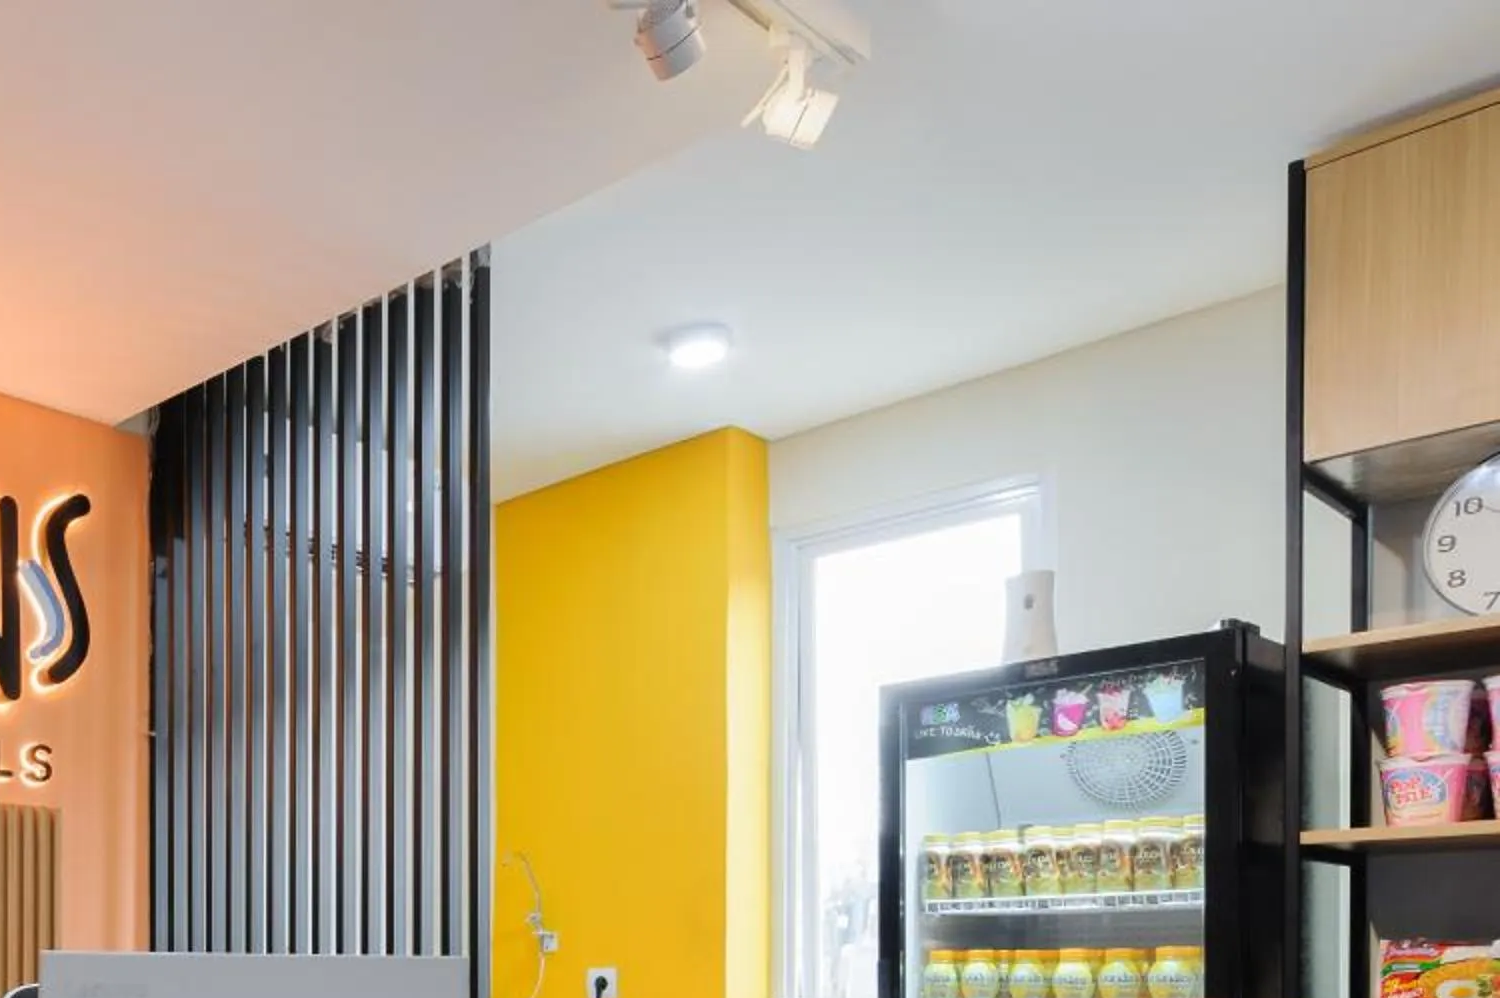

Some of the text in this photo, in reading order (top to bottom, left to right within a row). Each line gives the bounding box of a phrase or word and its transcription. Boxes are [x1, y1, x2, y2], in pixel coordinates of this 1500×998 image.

[1454, 497, 1484, 517] 10
[1437, 535, 1457, 553] 9
[1447, 569, 1467, 588] 8
[1483, 591, 1500, 611] 7
